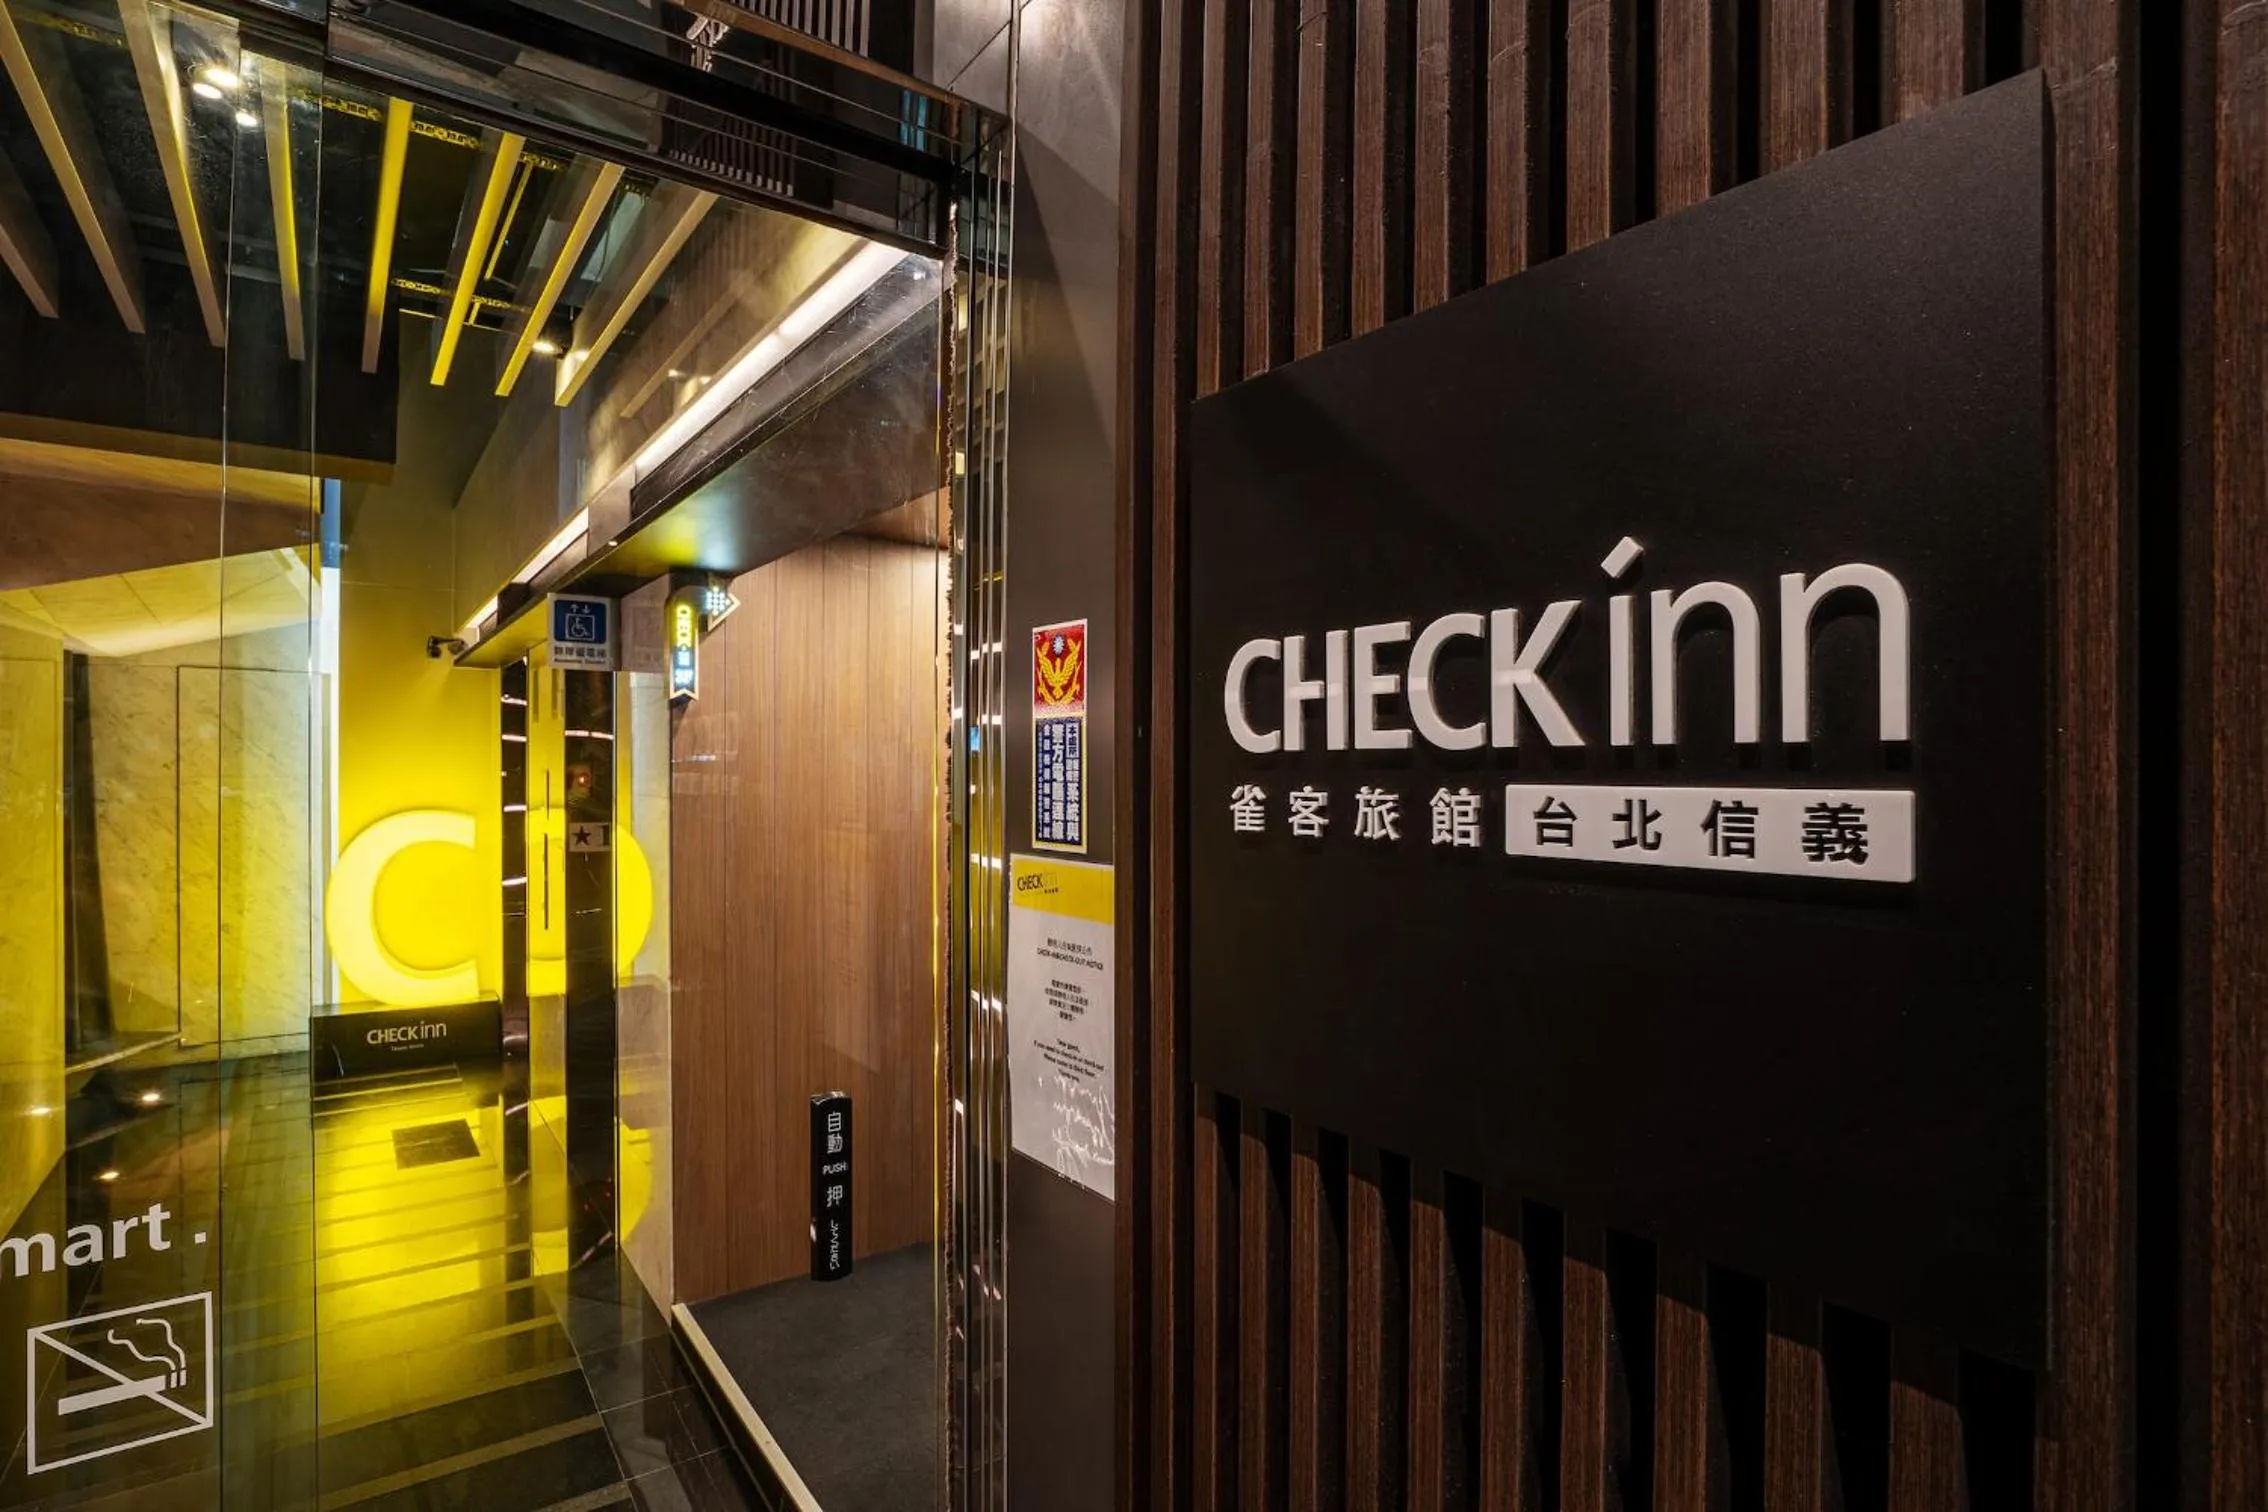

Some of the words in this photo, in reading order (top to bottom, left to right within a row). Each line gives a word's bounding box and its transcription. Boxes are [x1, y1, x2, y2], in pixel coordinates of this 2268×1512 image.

[1224, 601, 1585, 753] CHECK
[1601, 537, 1911, 747] inn
[1230, 784, 1482, 848] 雀客旅館
[1533, 796, 1869, 865] 台北信義
[367, 1026, 418, 1045] CHECK
[420, 1020, 447, 1040] inn
[827, 1112, 843, 1154] 自動
[823, 1162, 846, 1175] PUSH
